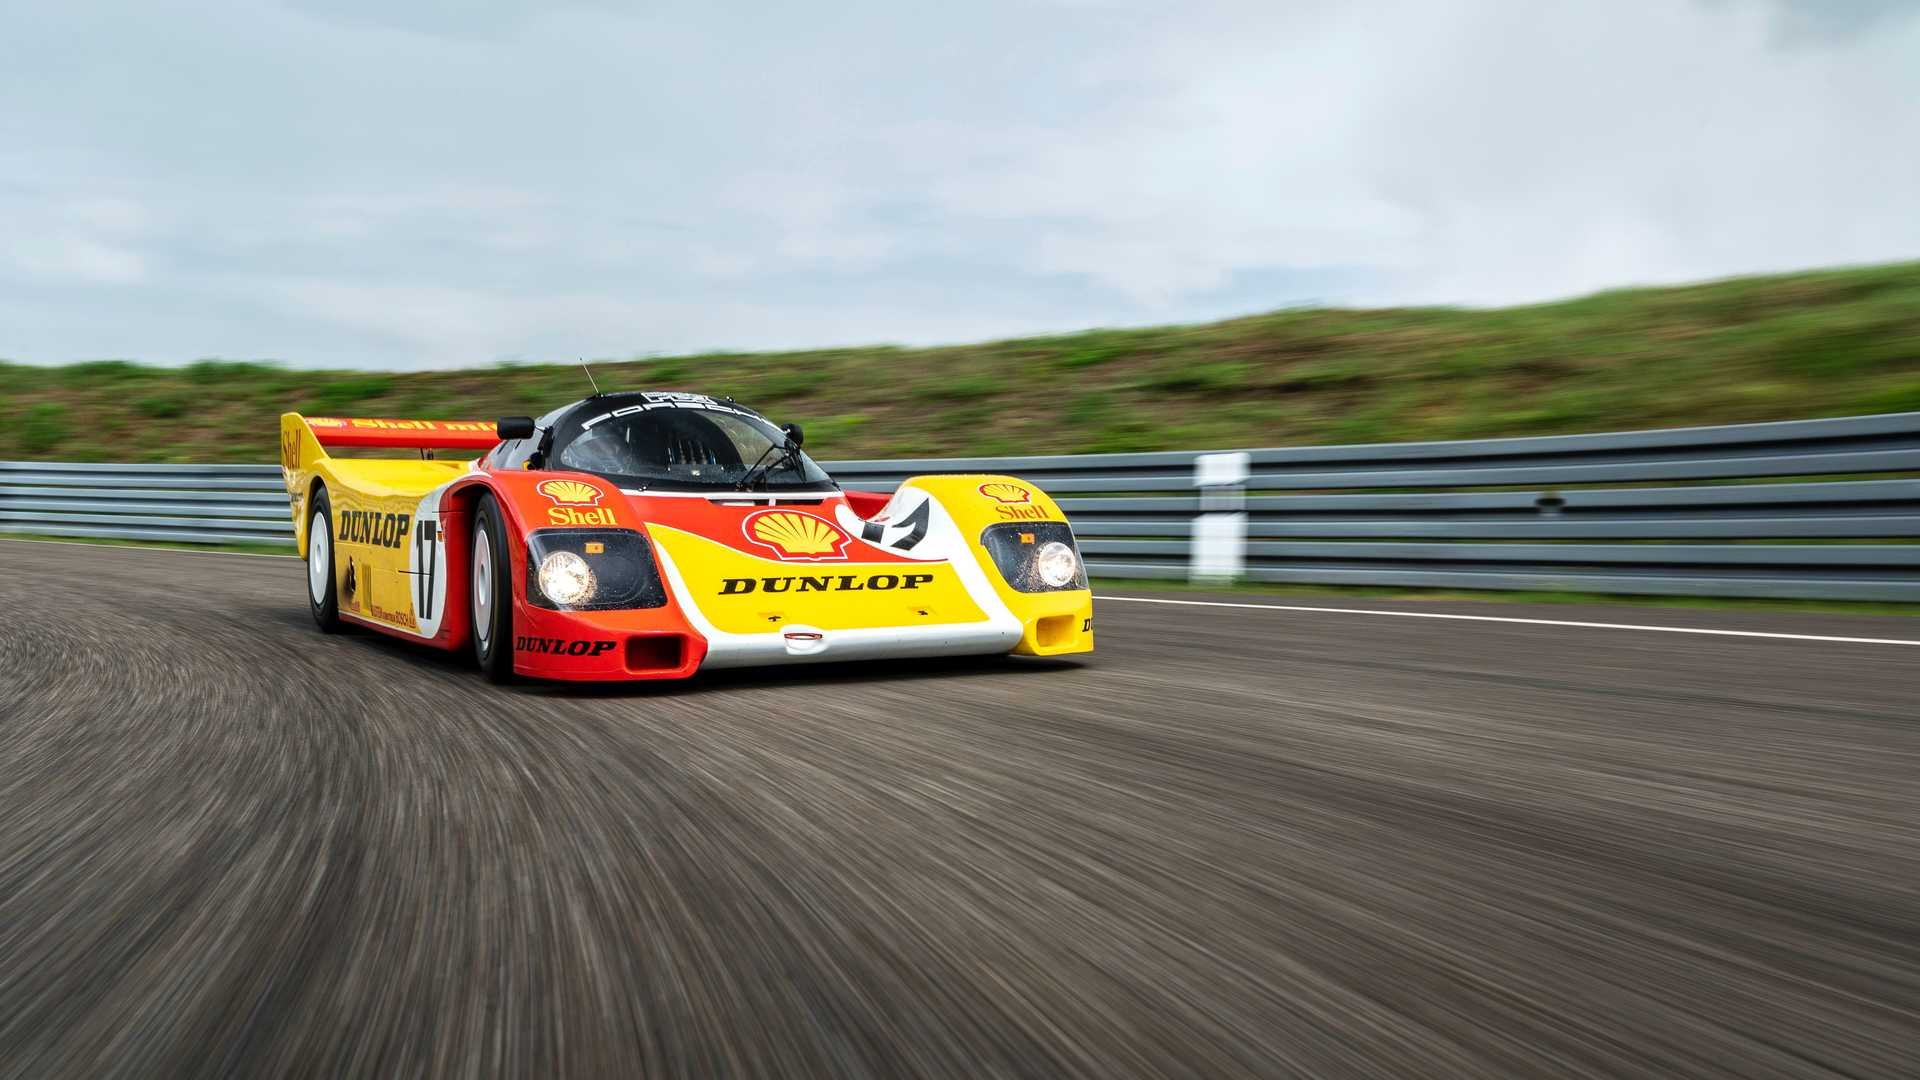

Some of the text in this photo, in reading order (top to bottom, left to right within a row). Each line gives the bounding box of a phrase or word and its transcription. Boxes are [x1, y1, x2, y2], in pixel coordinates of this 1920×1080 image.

[351, 418, 498, 432] Shell mi
[548, 507, 618, 526] Shell
[995, 504, 1049, 520] Shell
[339, 510, 410, 549] DUNLOP
[416, 520, 437, 620] 17
[718, 574, 934, 595] DUNLOP
[516, 636, 617, 656] DUNLOP
